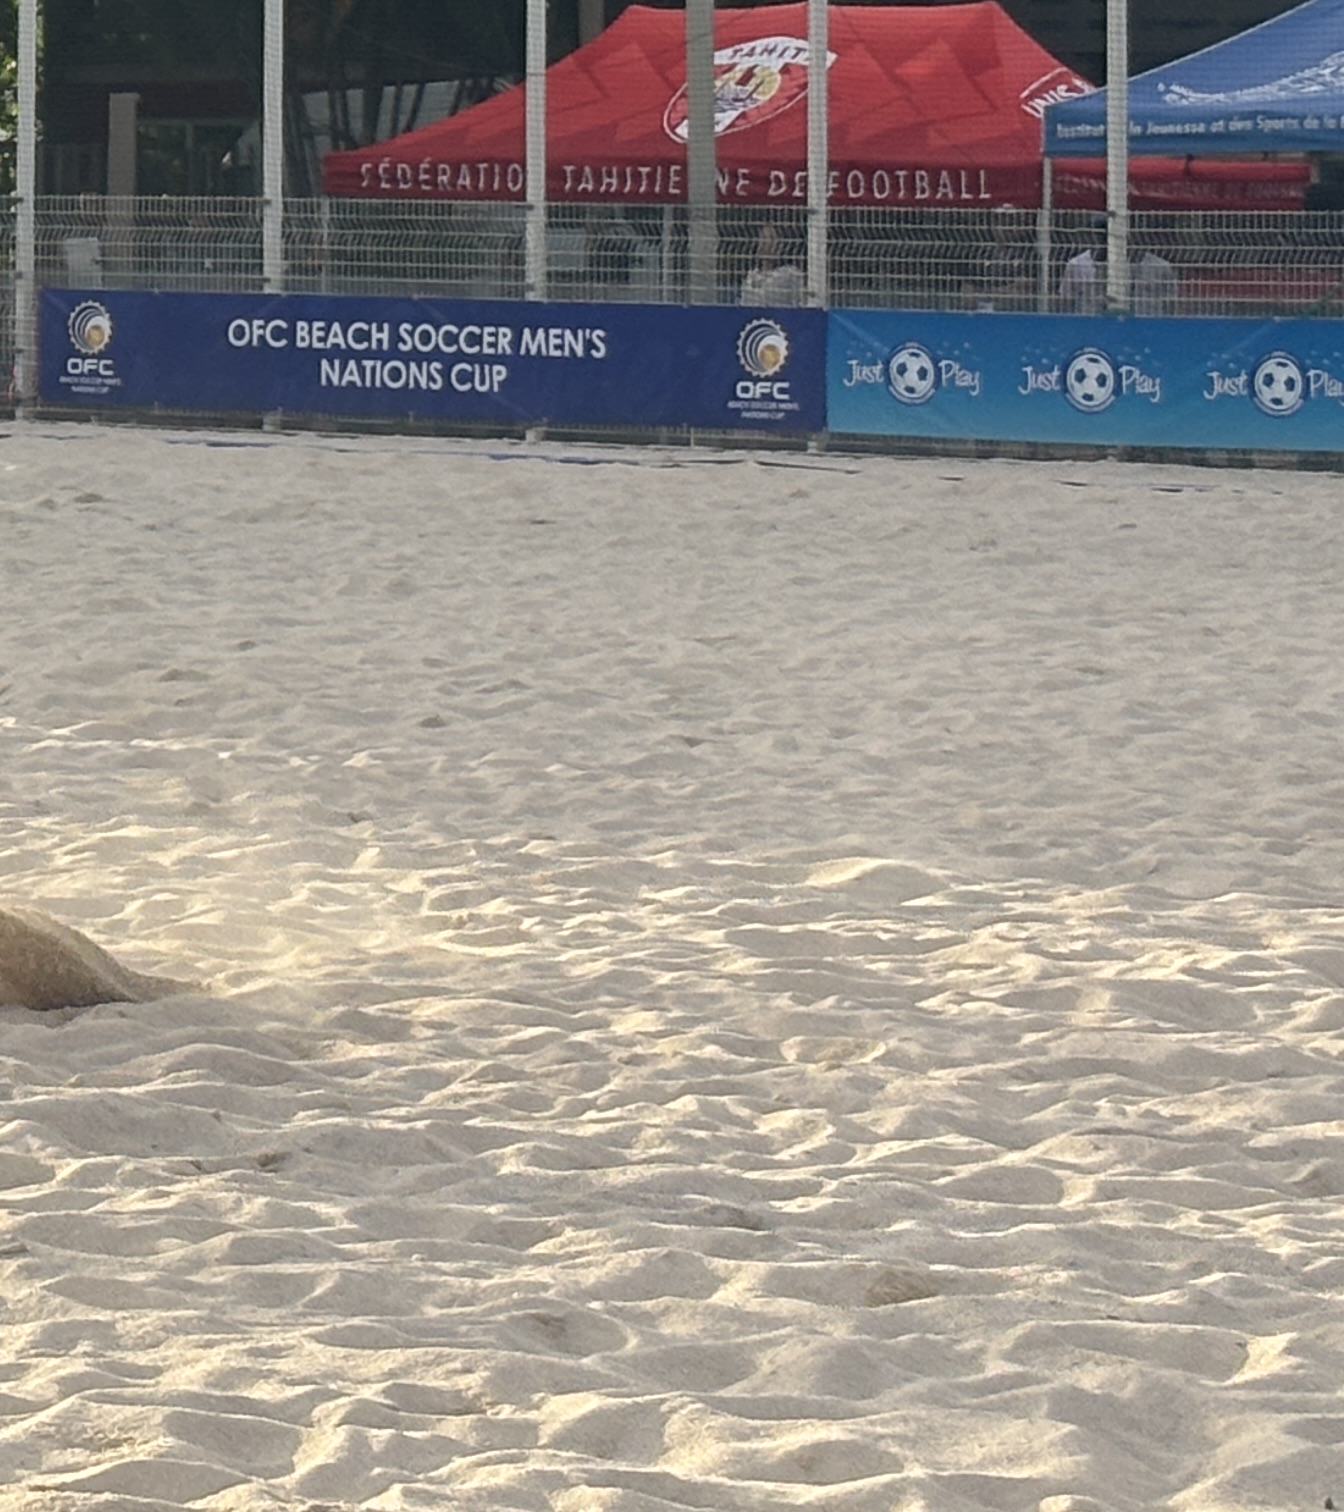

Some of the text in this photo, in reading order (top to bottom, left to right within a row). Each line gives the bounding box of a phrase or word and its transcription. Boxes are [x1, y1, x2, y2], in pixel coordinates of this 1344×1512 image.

[727, 43, 812, 62] TAHIT
[360, 157, 524, 189] FÉDÉRATIO
[563, 164, 750, 196] TAHITIENE
[824, 168, 992, 200] FOOTBALL
[227, 318, 607, 359] OFC BEACH SOCCER MEN'S
[66, 357, 115, 377] OFC
[320, 358, 508, 393] NATIONS CUP
[843, 359, 981, 397] Just Play
[1017, 364, 1162, 403] Just Play
[1203, 369, 1249, 400] Just
[735, 381, 791, 401] OFC
